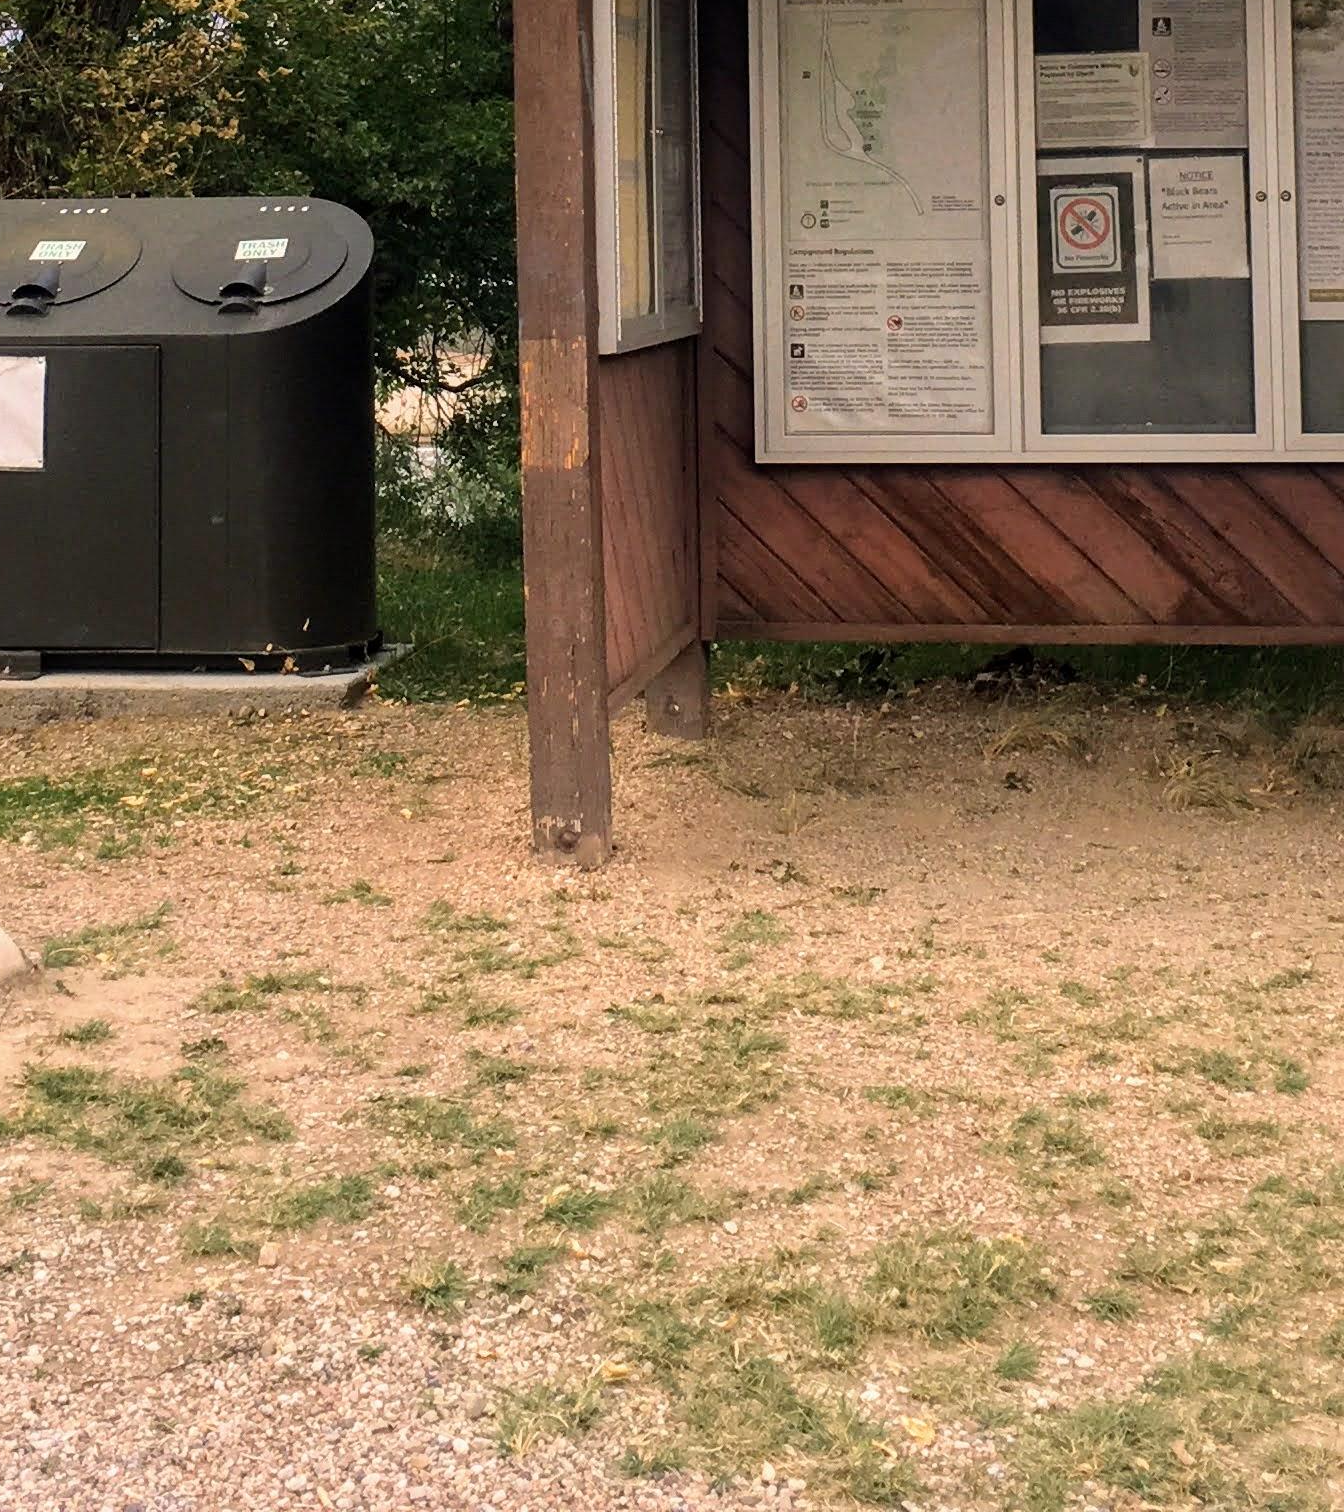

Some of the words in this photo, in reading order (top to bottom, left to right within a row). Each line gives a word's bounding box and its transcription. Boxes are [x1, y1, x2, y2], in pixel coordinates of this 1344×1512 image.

[1179, 171, 1214, 181] NOTICE
[241, 240, 286, 249] TRASH
[1051, 289, 1066, 297] NO
[1068, 287, 1126, 296] EXPLOSIVES
[1069, 296, 1125, 305] FIREWORKS
